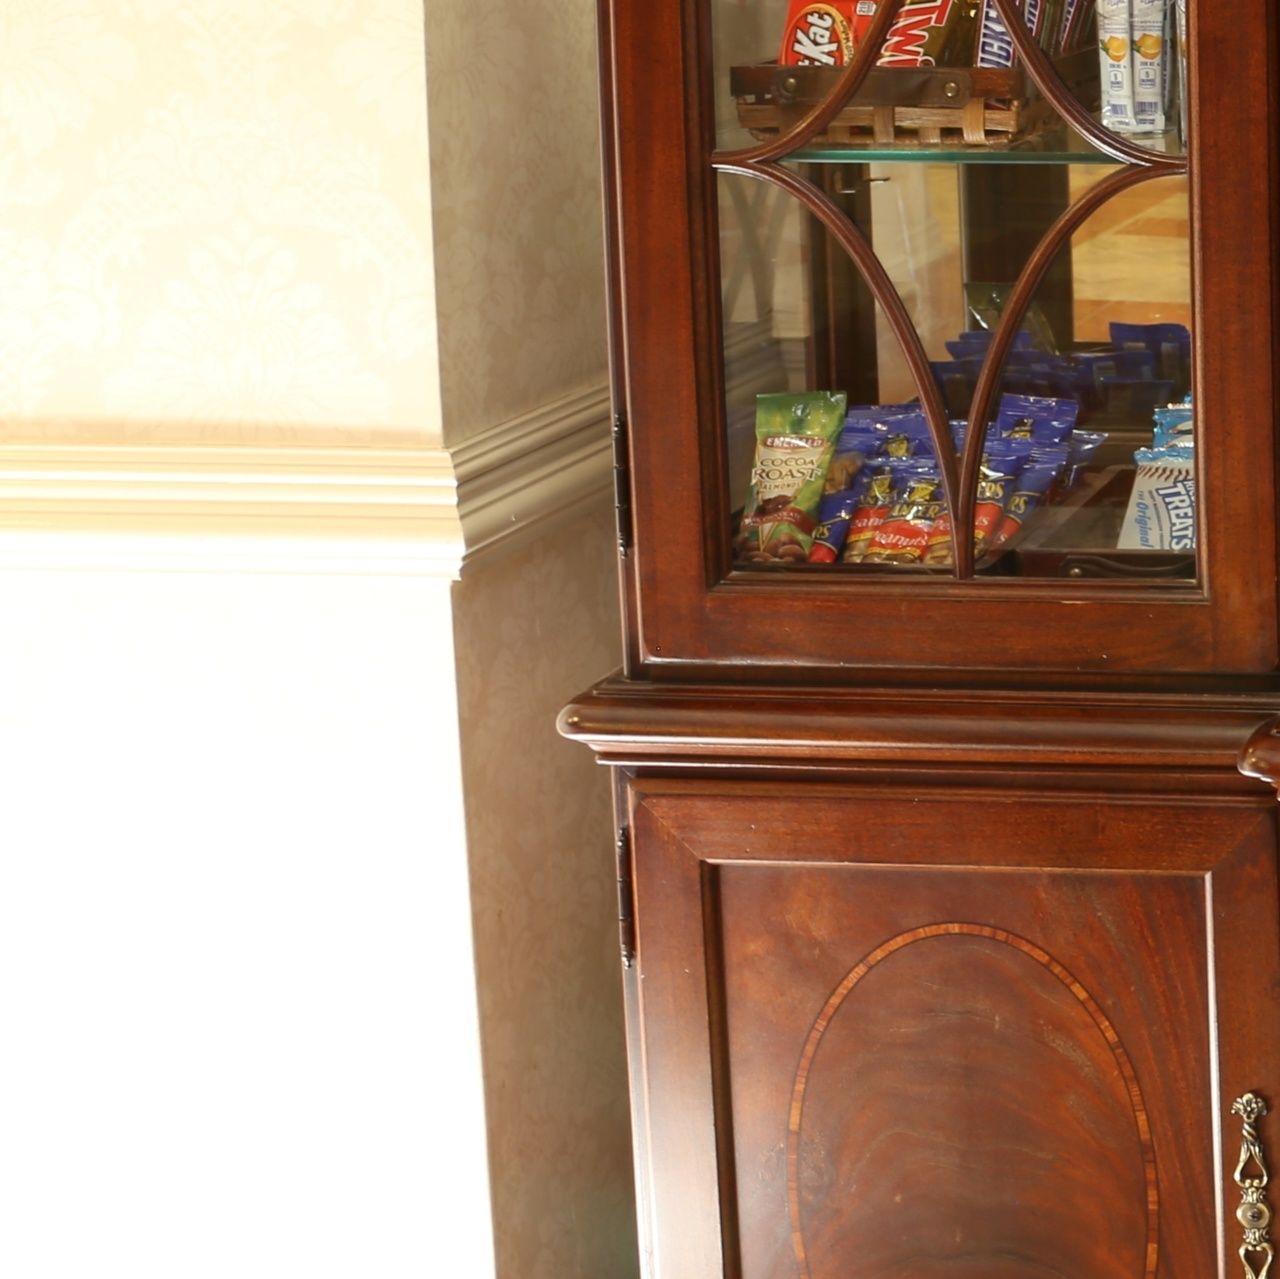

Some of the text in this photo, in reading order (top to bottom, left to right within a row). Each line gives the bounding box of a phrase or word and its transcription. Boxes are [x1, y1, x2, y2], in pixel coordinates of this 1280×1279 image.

[793, 12, 838, 65] Kat
[753, 467, 819, 481] ROAST
[760, 457, 816, 467] COCOA
[1134, 501, 1154, 549] Original
[1155, 480, 1194, 549] TREATS
